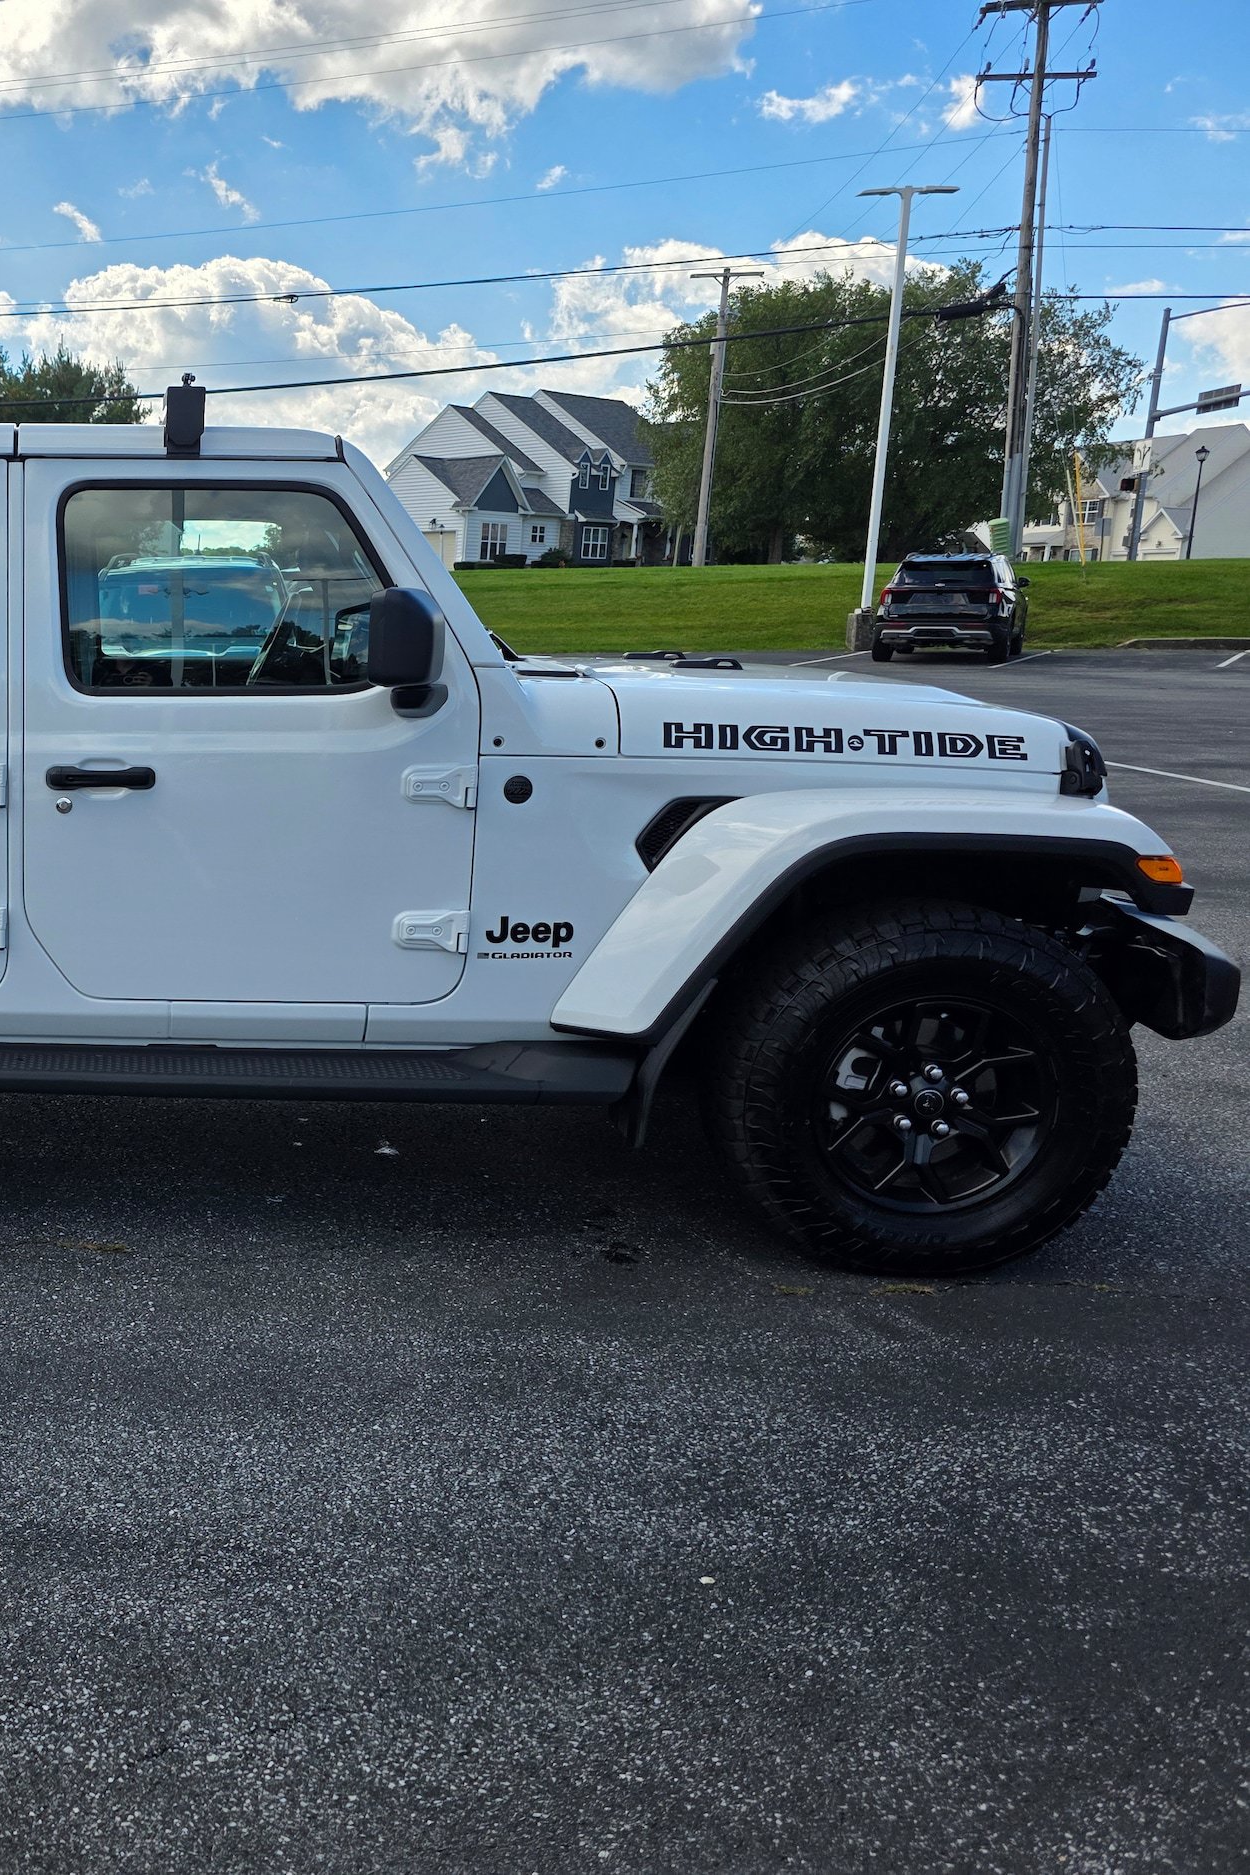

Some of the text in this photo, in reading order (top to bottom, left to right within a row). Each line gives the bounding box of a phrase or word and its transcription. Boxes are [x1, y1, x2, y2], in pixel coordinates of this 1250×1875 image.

[663, 722, 1028, 761] HIGH TIDE
[485, 915, 575, 949] Jeep
[491, 951, 573, 960] GLADIATOR
